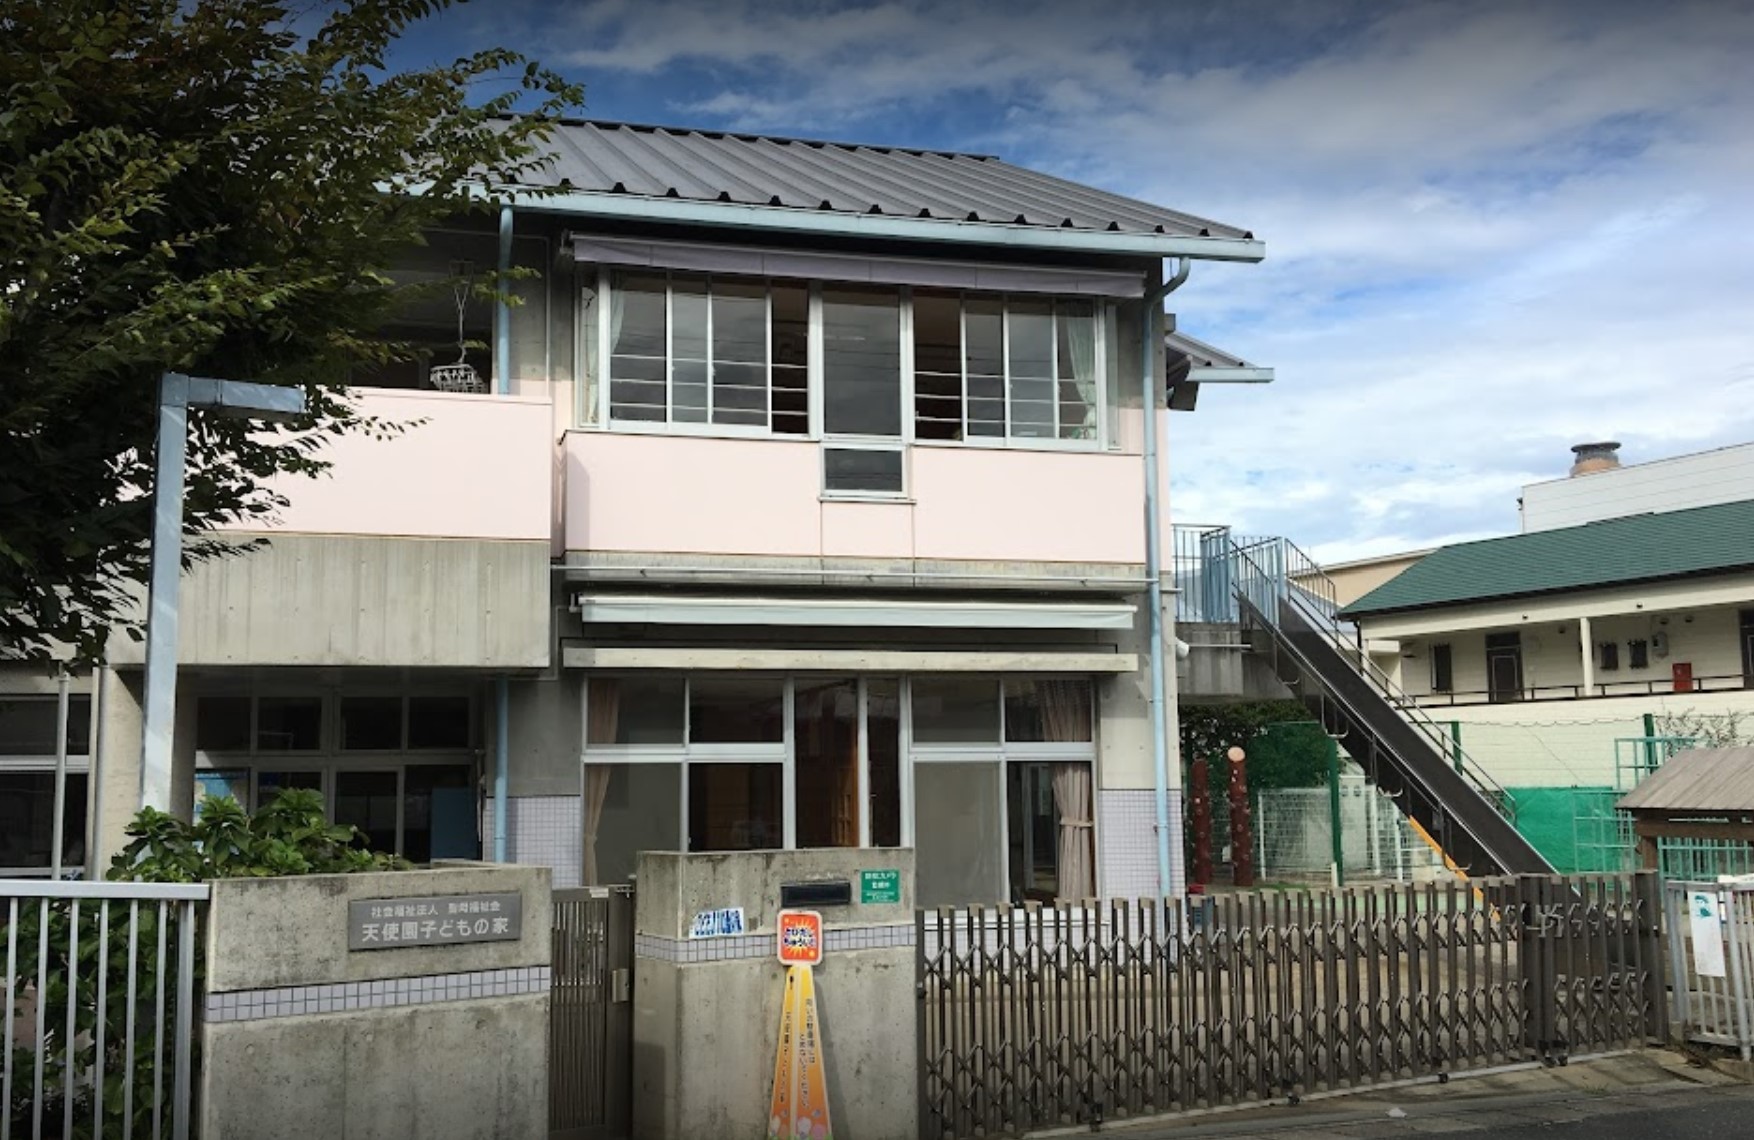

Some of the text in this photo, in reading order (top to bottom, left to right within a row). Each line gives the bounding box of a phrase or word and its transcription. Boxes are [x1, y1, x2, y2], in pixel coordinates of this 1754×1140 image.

[371, 905, 439, 918] 社会福祉法人
[362, 917, 509, 942] 天使園子どもの家
